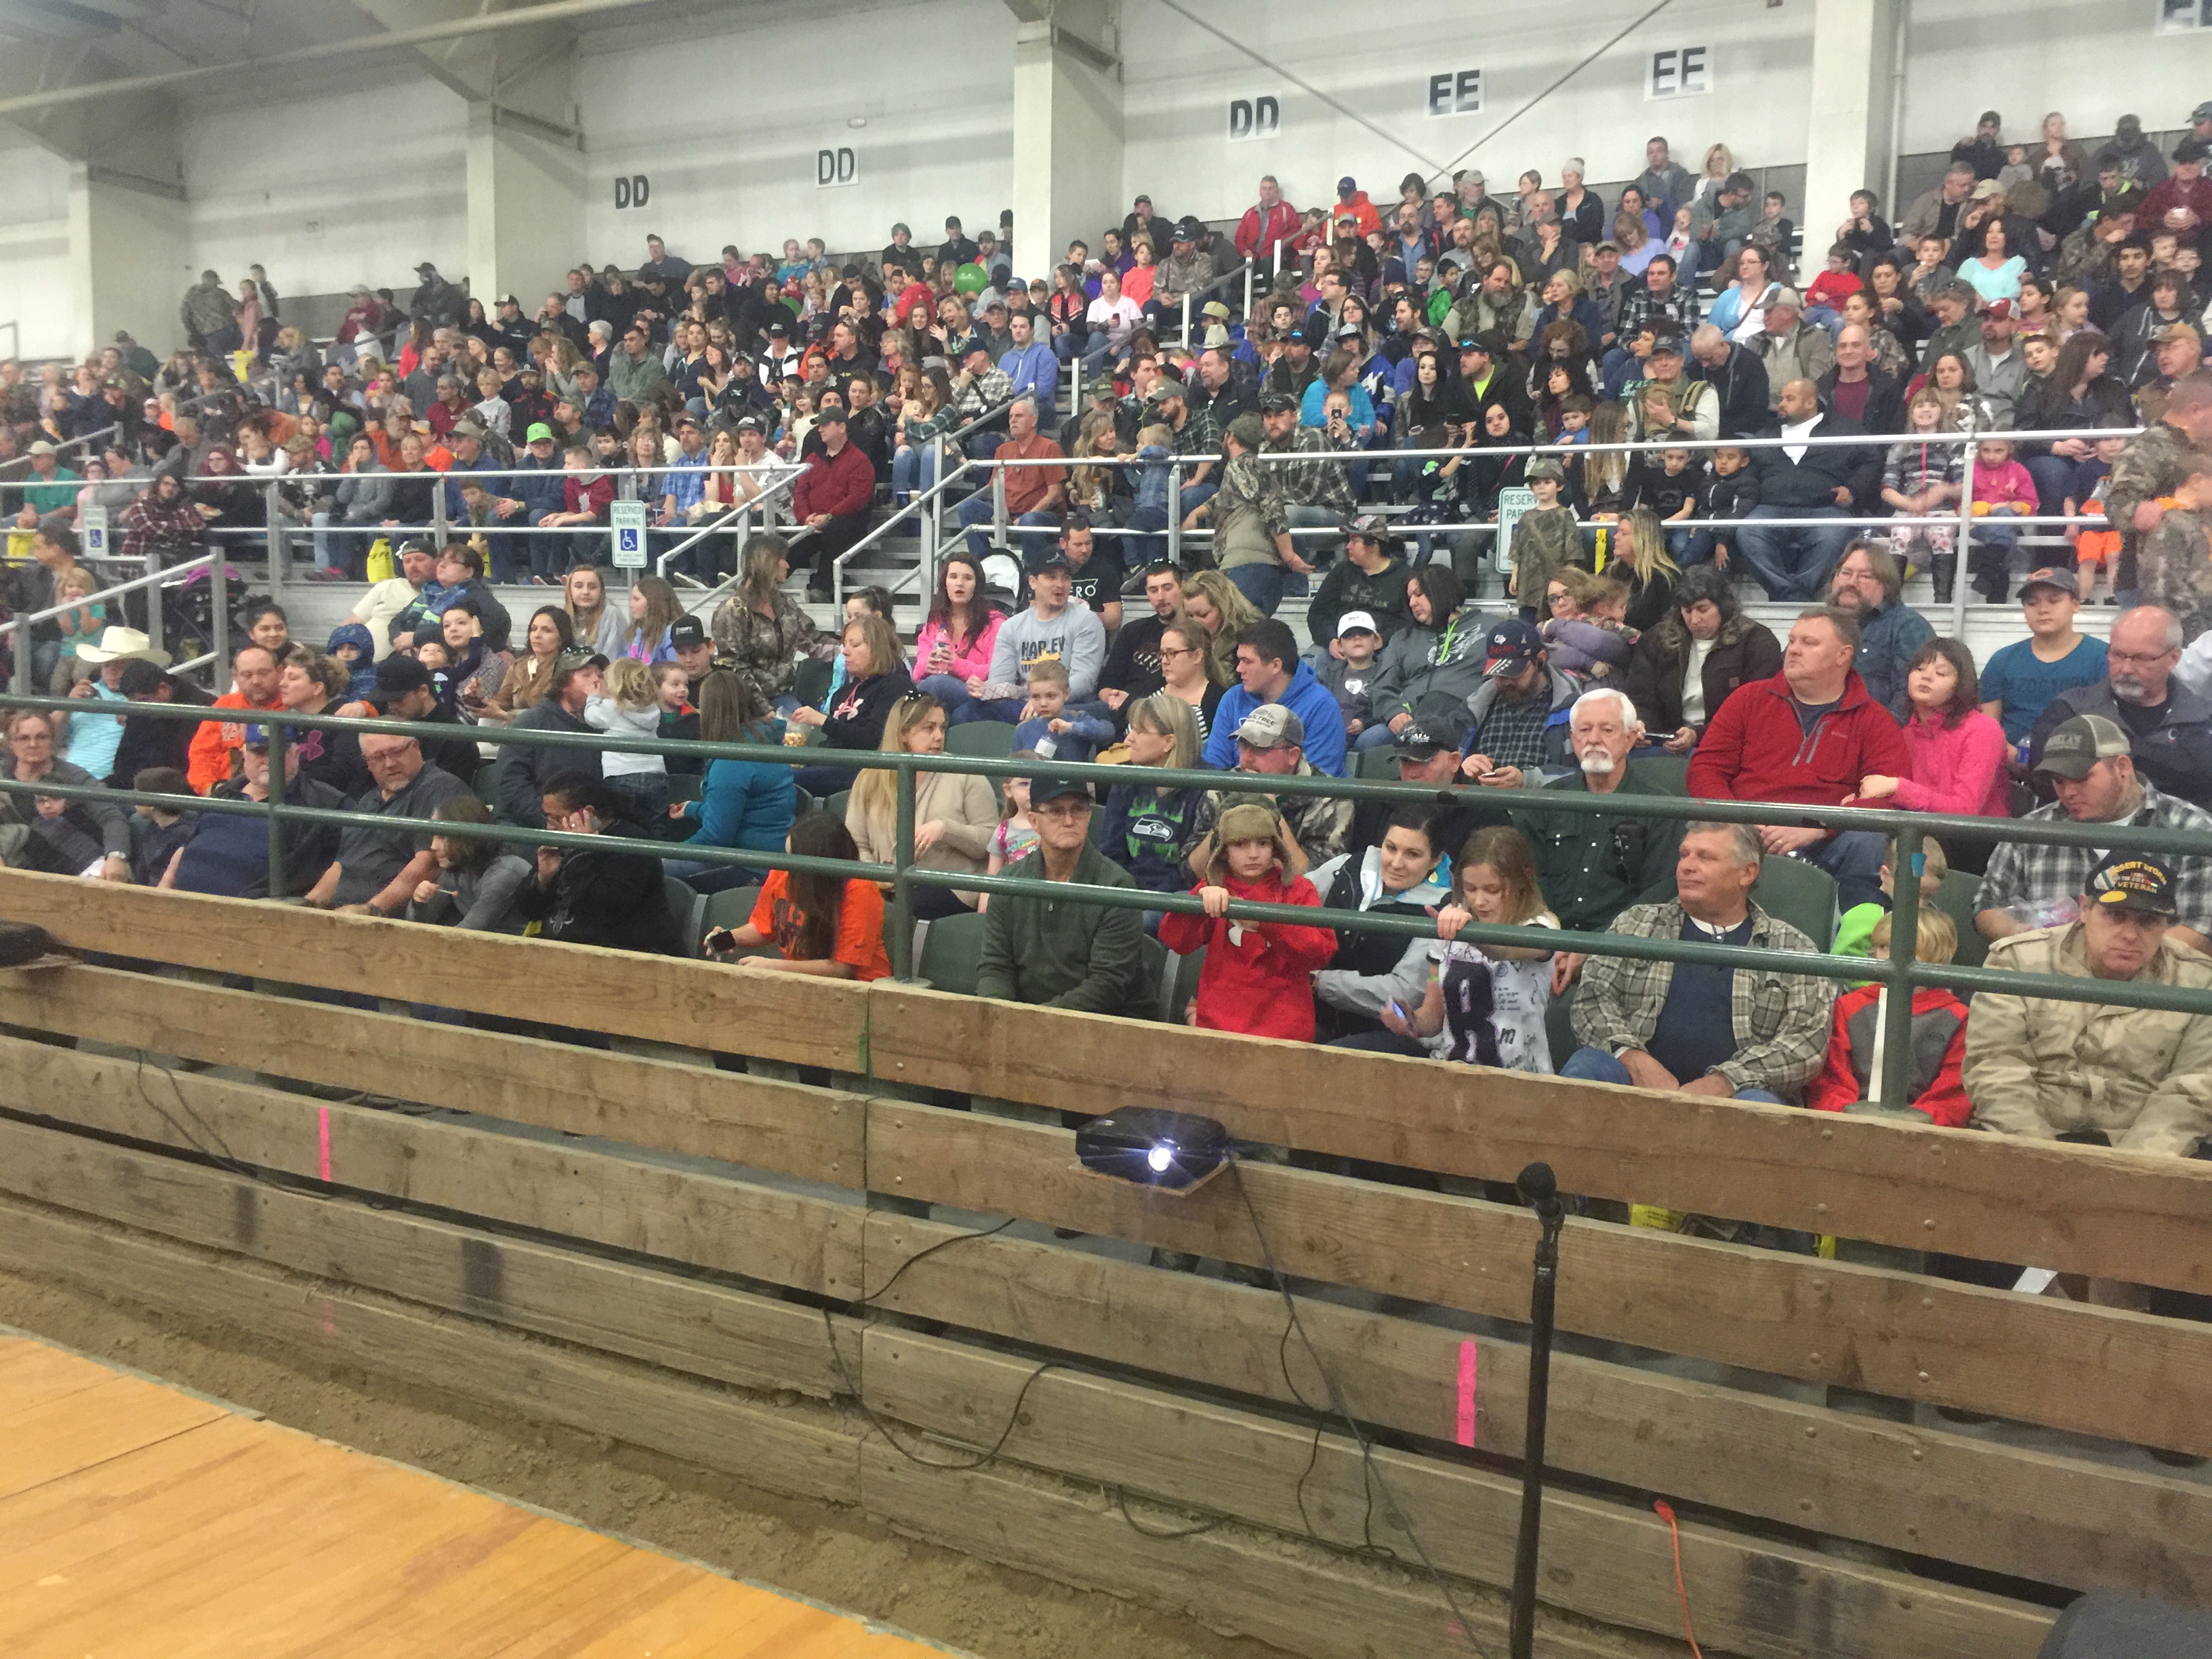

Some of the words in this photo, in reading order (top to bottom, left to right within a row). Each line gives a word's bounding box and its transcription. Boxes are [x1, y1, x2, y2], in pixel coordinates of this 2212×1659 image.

[1653, 46, 1706, 96] EE
[1429, 69, 1480, 115] EE
[1230, 96, 1279, 139] DD
[818, 147, 855, 185] DD
[615, 175, 649, 209] DD
[613, 506, 642, 514] RESERVED
[1504, 494, 1538, 506] RESERV
[615, 517, 640, 525] PARKING
[2117, 882, 2157, 894] VETERAN
